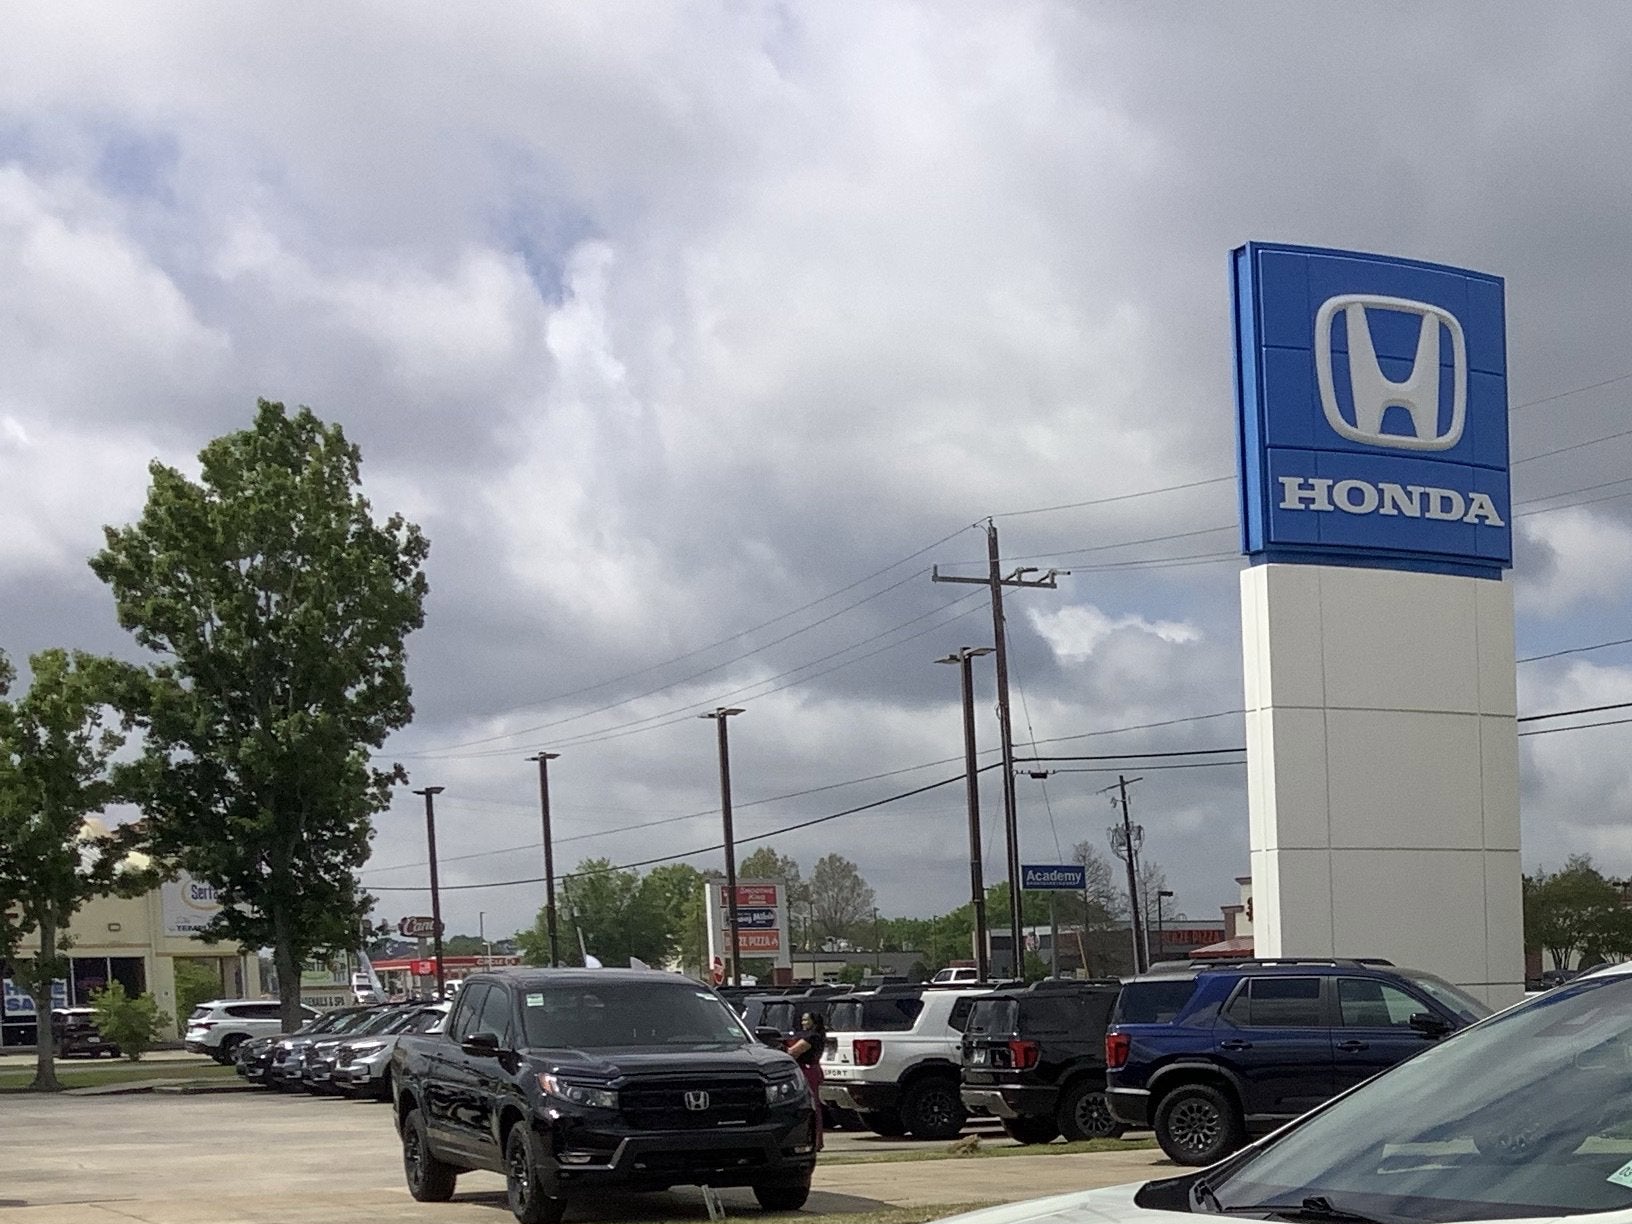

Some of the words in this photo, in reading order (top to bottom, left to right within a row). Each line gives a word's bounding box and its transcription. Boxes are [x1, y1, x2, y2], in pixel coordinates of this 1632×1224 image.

[1278, 476, 1505, 527] HONDA
[1026, 870, 1082, 885] Academy
[749, 936, 770, 947] PIZZA
